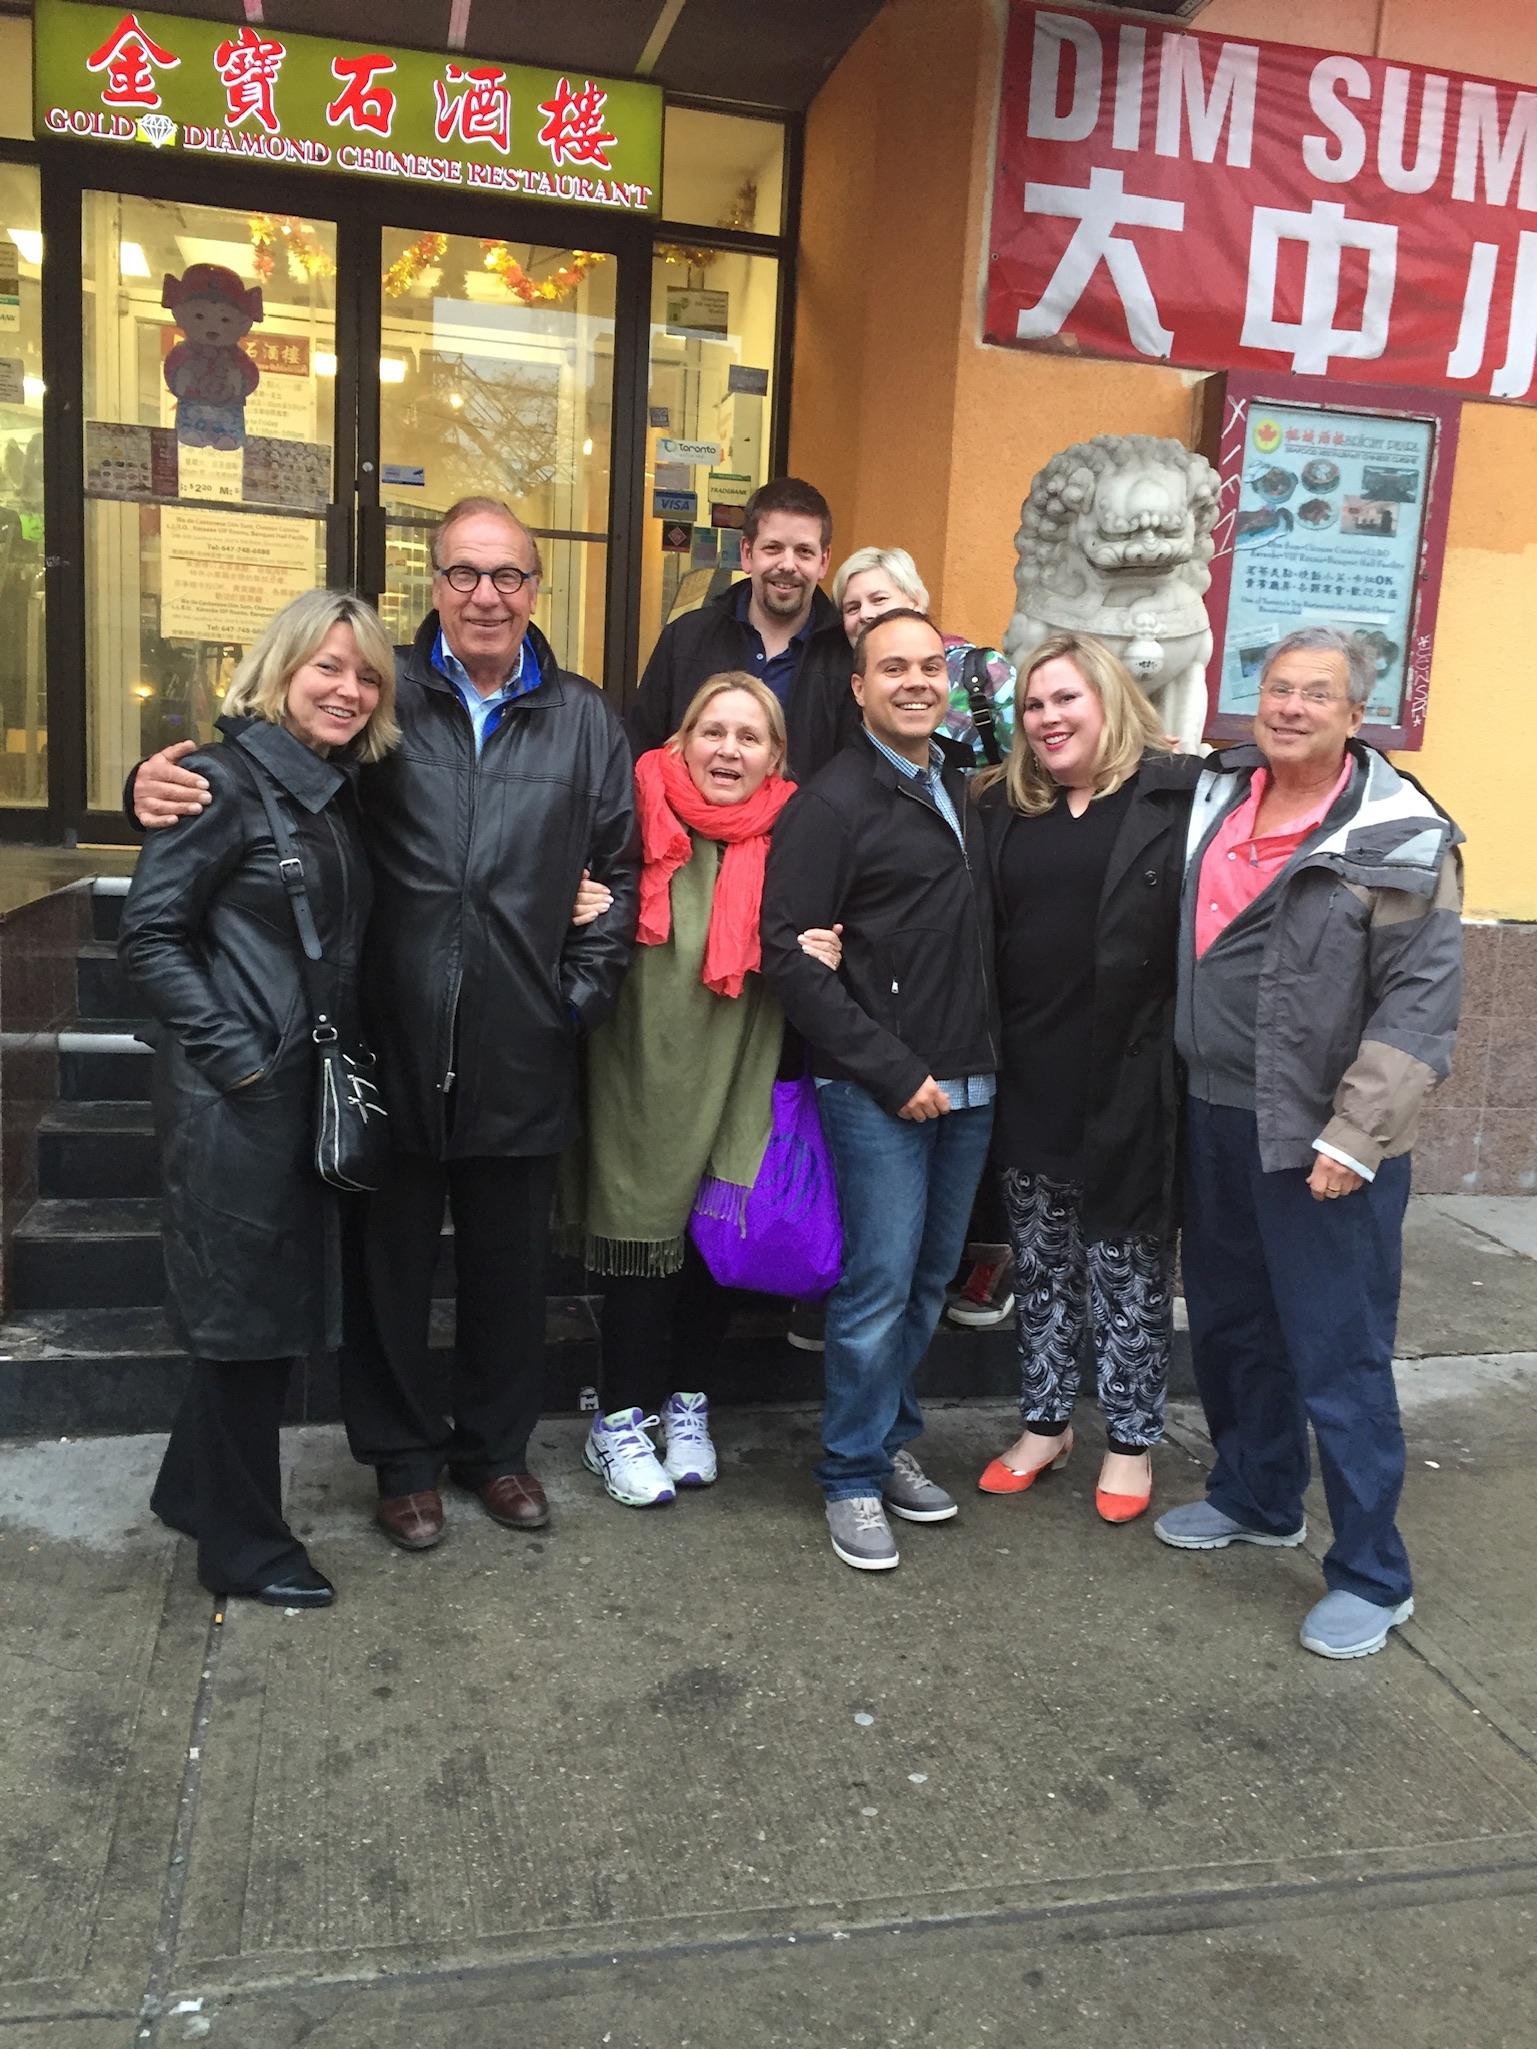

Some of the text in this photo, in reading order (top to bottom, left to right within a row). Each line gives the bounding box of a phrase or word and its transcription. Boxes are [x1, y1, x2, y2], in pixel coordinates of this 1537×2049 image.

[87, 13, 618, 168] 金寶石酒樓
[1027, 10, 1537, 212] DIM SUM
[45, 106, 653, 210] GOLD DIAMOND CHINESE RESTAURANT
[679, 443, 717, 454] Toronto
[661, 499, 690, 511] VISA
